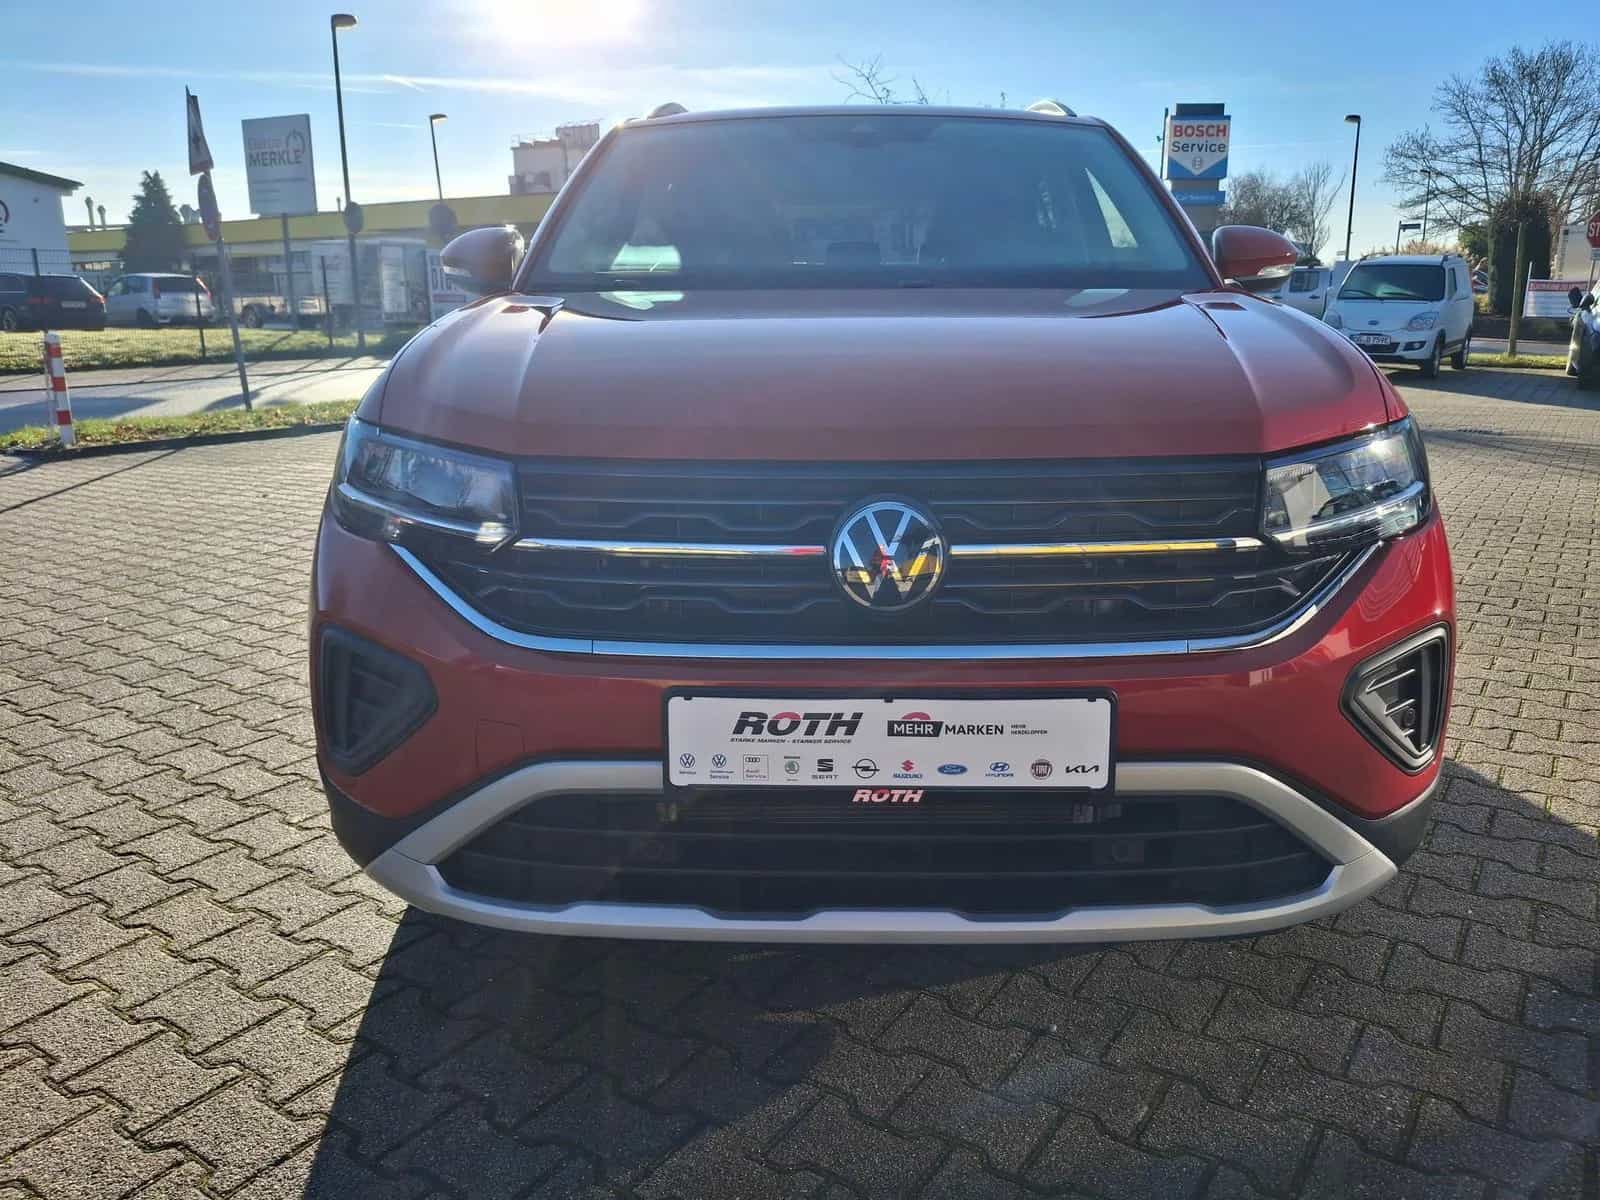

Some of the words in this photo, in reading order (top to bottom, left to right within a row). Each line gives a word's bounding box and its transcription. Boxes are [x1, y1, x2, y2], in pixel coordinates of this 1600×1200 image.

[1173, 124, 1227, 138] BOSCH
[1171, 140, 1226, 153] Service
[248, 149, 303, 168] MERKLE
[732, 711, 864, 737] ROTH
[893, 723, 934, 735] MEHR
[945, 724, 1004, 735] MARKEN
[1065, 764, 1100, 774] KIA
[852, 789, 924, 803] ROTH
